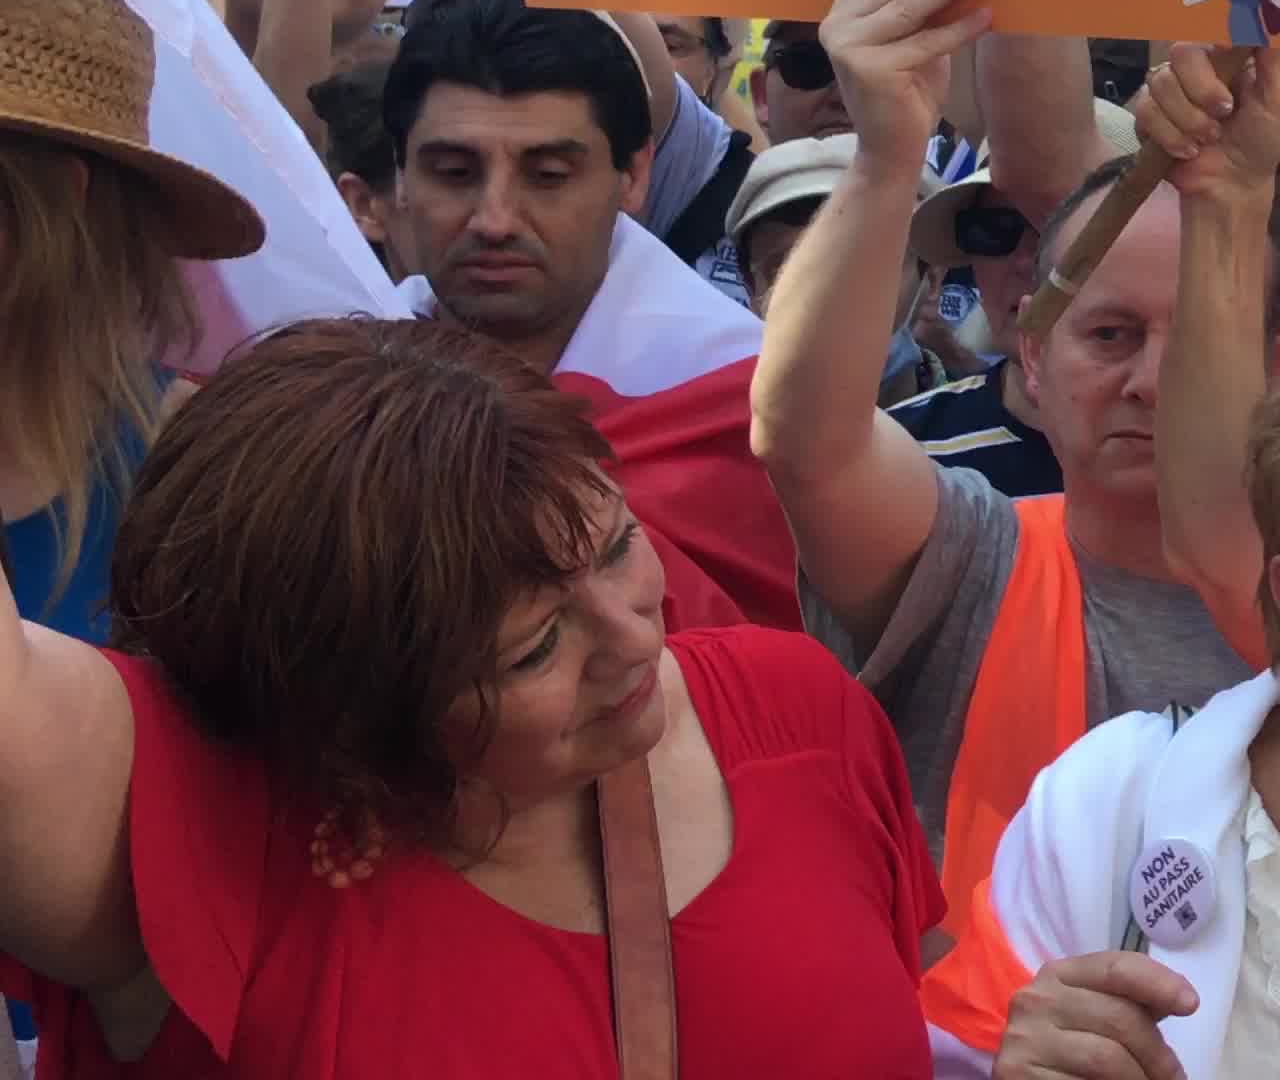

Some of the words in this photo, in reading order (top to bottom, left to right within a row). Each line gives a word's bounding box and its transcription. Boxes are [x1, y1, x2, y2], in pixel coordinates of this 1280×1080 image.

[1141, 844, 1176, 884] NON
[1143, 885, 1160, 909] AU
[1158, 856, 1191, 891] PASS
[1145, 865, 1204, 928] SANITAIRE
